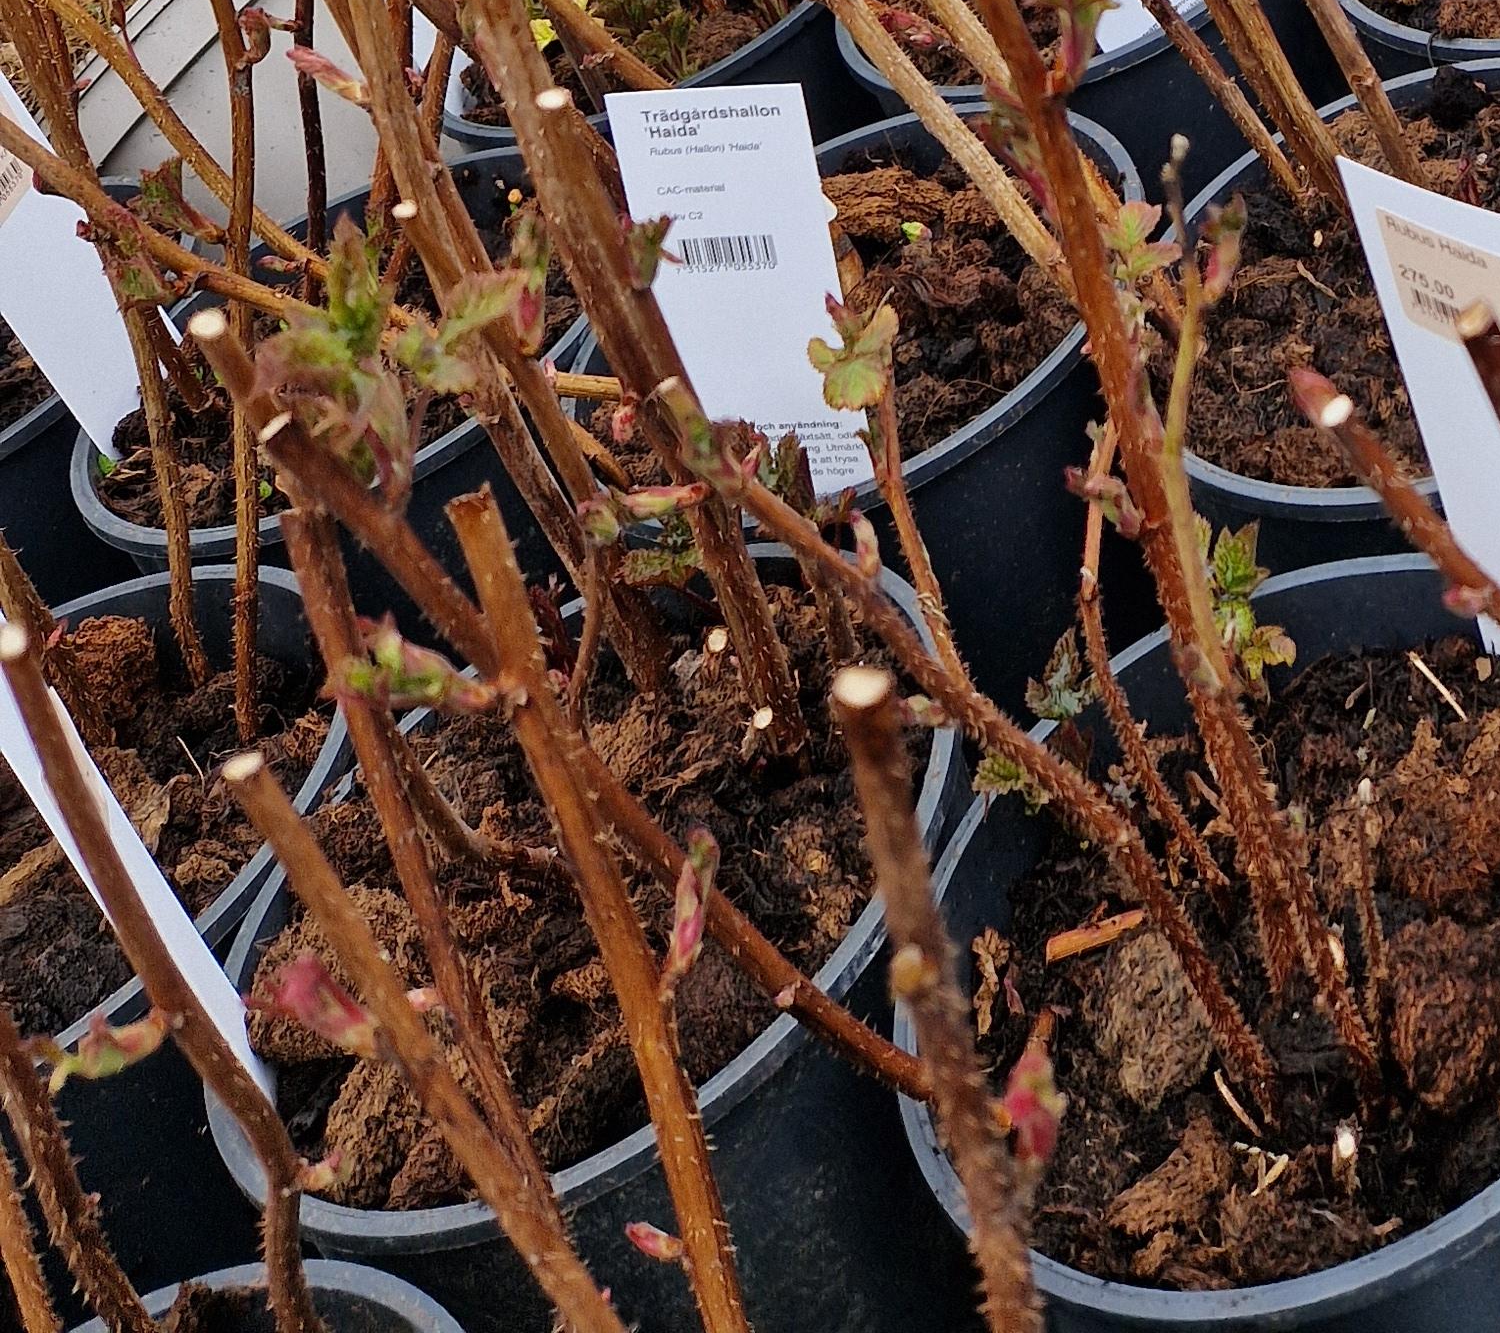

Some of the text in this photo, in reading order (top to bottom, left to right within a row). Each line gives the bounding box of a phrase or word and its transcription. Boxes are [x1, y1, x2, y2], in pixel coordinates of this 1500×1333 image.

[640, 105, 781, 124] Trädgårdshallon
[644, 124, 701, 139] 'Haida'
[650, 141, 762, 156] Rubus (Hallon) 'Haida'
[657, 183, 726, 196] CAC-material
[688, 211, 703, 220] C2
[1385, 215, 1488, 269] Rubus Haida
[1398, 263, 1454, 299] 275.00
[779, 421, 843, 430] användning:
[835, 455, 859, 464] frysa
[827, 466, 855, 476] högre
